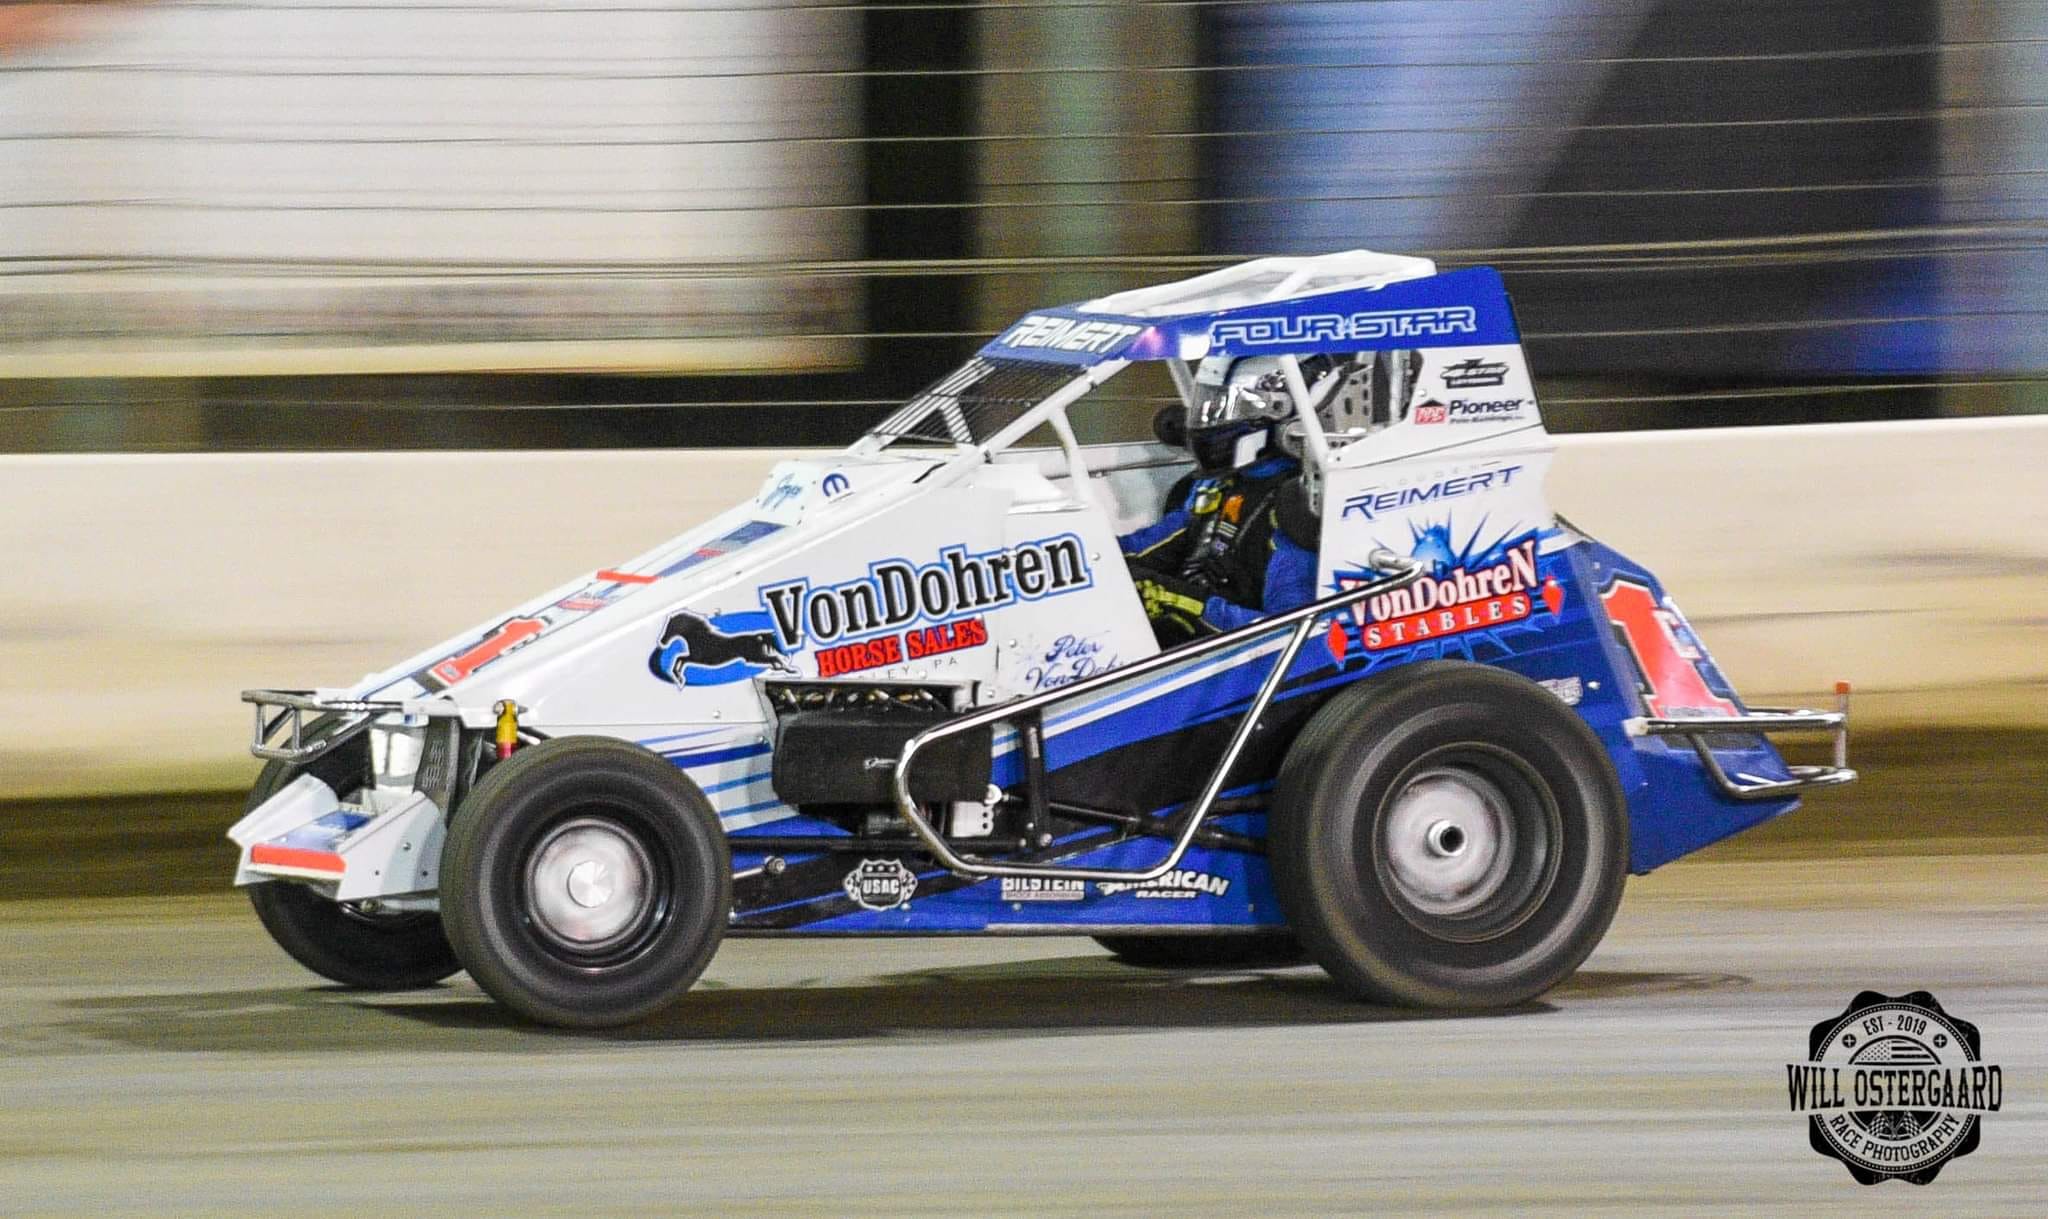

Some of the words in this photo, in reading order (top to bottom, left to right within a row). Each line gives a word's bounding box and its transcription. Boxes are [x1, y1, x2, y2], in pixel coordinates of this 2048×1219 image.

[1001, 316, 1142, 354] REIMERT
[1211, 315, 1345, 347] FOUR
[1350, 306, 1477, 340] STAR
[1449, 399, 1524, 415] Pioneer
[1341, 465, 1523, 520] REIMERT
[763, 536, 1089, 648] VonDohren
[1367, 596, 1526, 647] STABLES
[816, 637, 902, 677] HORSE
[905, 617, 988, 660] SALES
[1045, 634, 1103, 662] Peter
[862, 879, 900, 894] USAC
[1136, 890, 1197, 899] RACER
